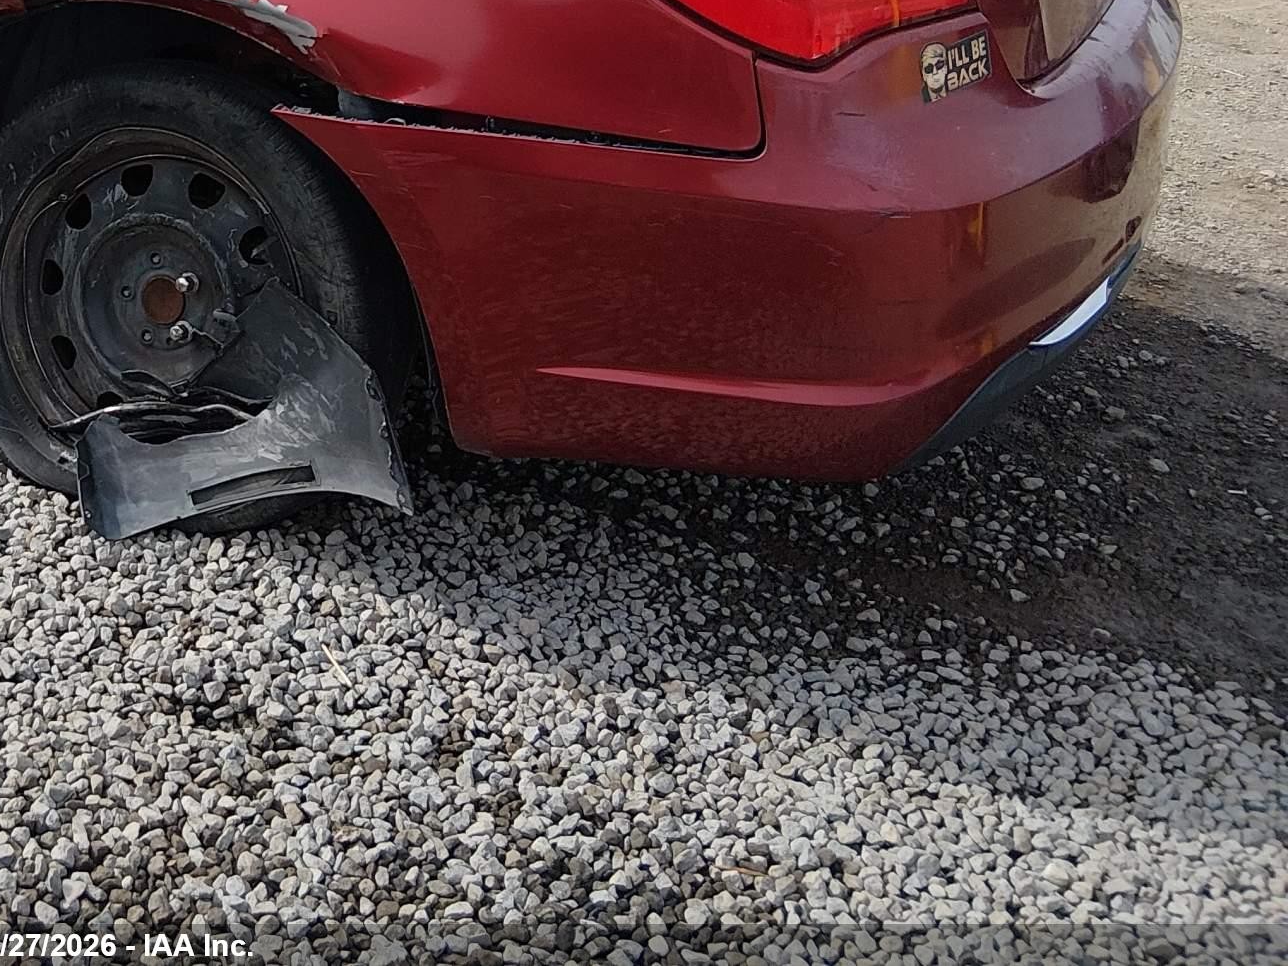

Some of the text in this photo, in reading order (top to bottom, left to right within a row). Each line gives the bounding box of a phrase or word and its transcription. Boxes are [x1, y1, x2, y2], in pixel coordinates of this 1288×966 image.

[947, 36, 987, 70] I'LL BE
[947, 57, 989, 91] BACK
